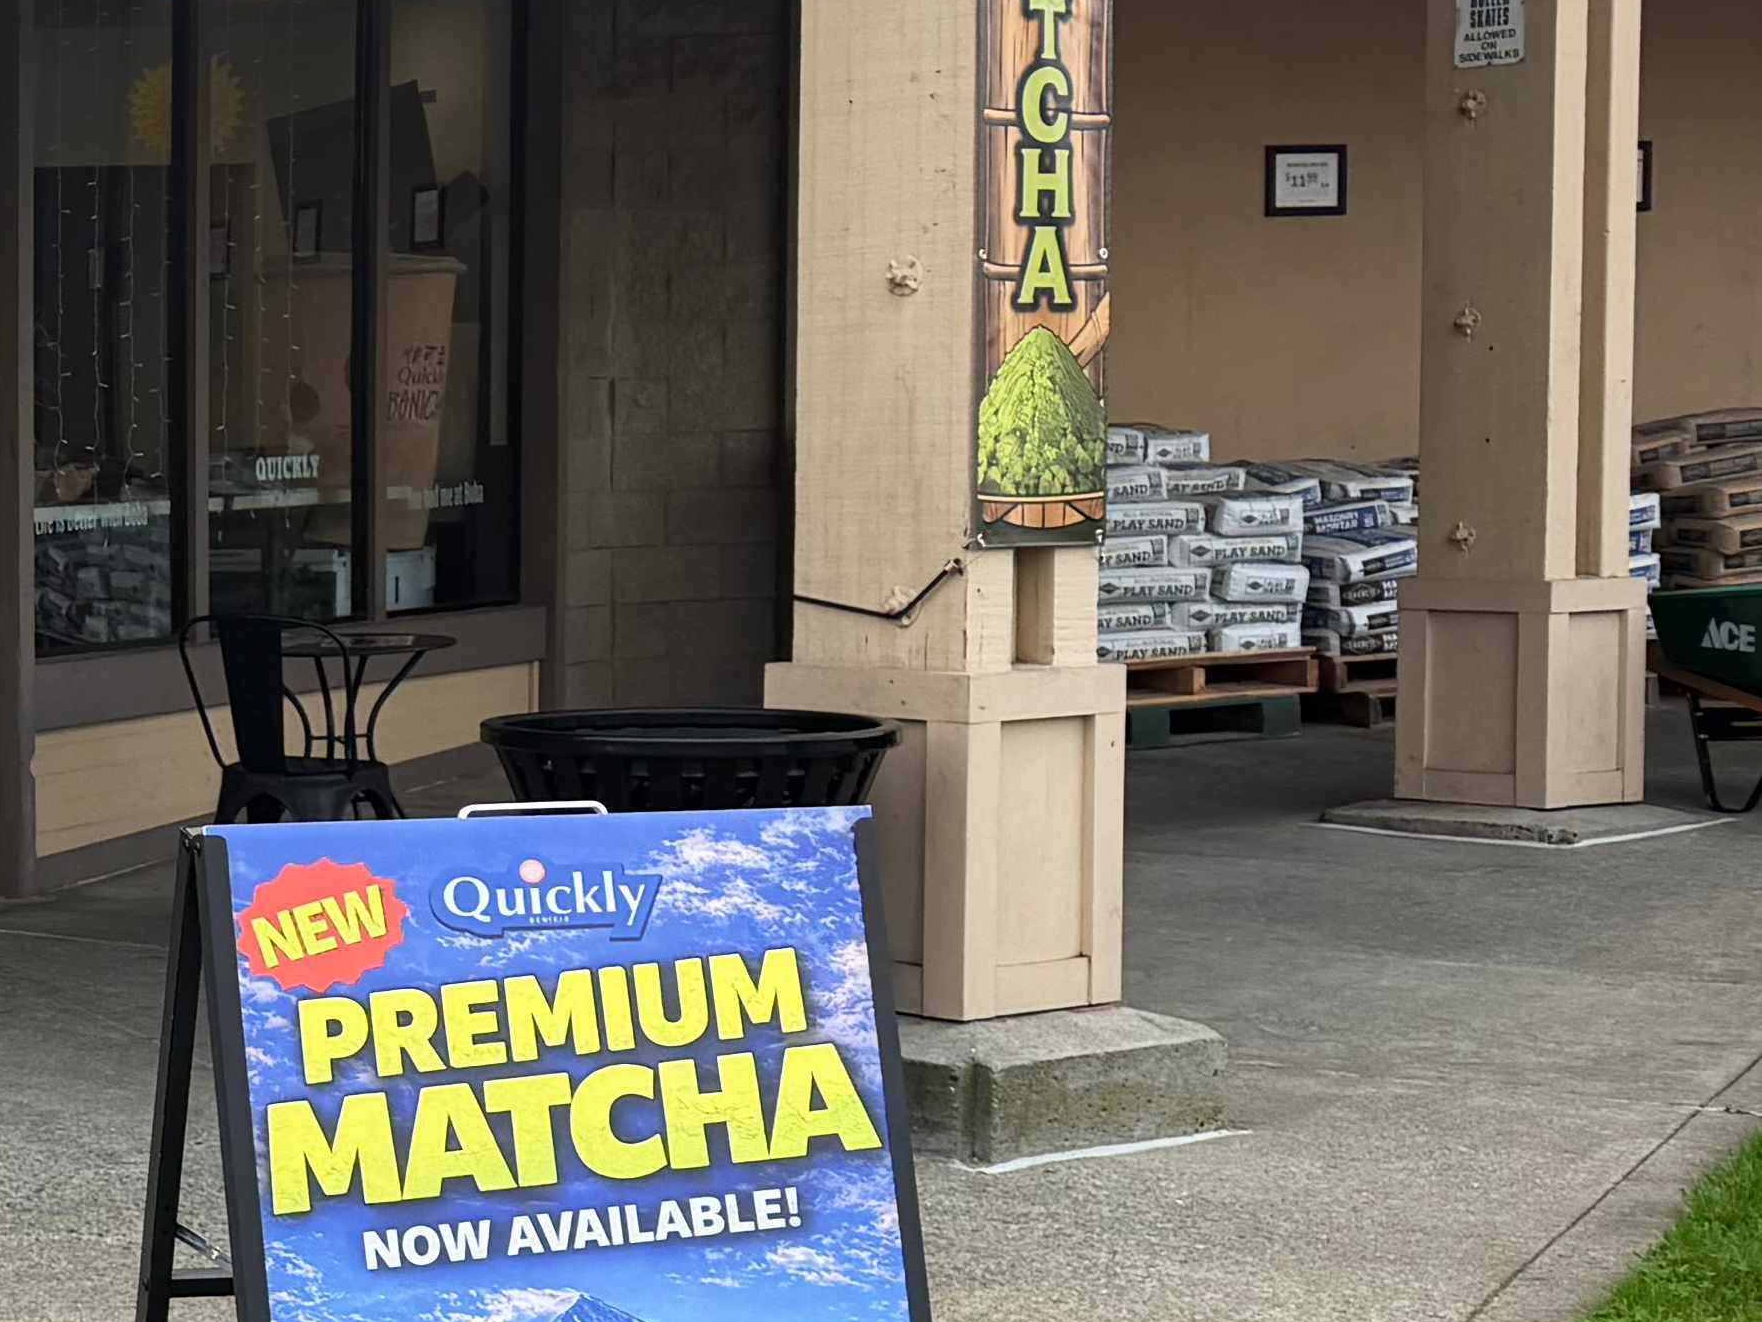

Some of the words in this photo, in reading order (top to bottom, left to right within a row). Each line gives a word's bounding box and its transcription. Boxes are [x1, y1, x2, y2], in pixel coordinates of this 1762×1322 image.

[1469, 7, 1511, 28] SKATES
[1463, 28, 1517, 42] ALLOWED
[1480, 40, 1498, 51] ON
[1458, 48, 1520, 64] SIDEWALKS
[255, 454, 321, 481] QUICKLY
[1114, 486, 1148, 497] SAND
[1113, 518, 1144, 530] PLAY
[1147, 517, 1184, 529] SAND
[1115, 551, 1151, 564] SAND
[1214, 548, 1247, 560] PLAY
[1249, 545, 1286, 557] SAND
[1122, 586, 1154, 597] PLAY
[1157, 584, 1194, 595] SAND
[1116, 614, 1152, 627] SAND
[1214, 612, 1247, 624] PLAY
[1249, 610, 1285, 621] SAND
[1700, 617, 1757, 653] ACE
[1116, 649, 1149, 661] PLAY
[1151, 646, 1187, 658] SAND
[441, 859, 647, 926] Quickly
[249, 883, 389, 968] NEW
[296, 945, 808, 1086] PREMIUM
[265, 1041, 883, 1216] MATCHA
[362, 1219, 491, 1271] NOW
[506, 1186, 803, 1257] AVAILABLE!
